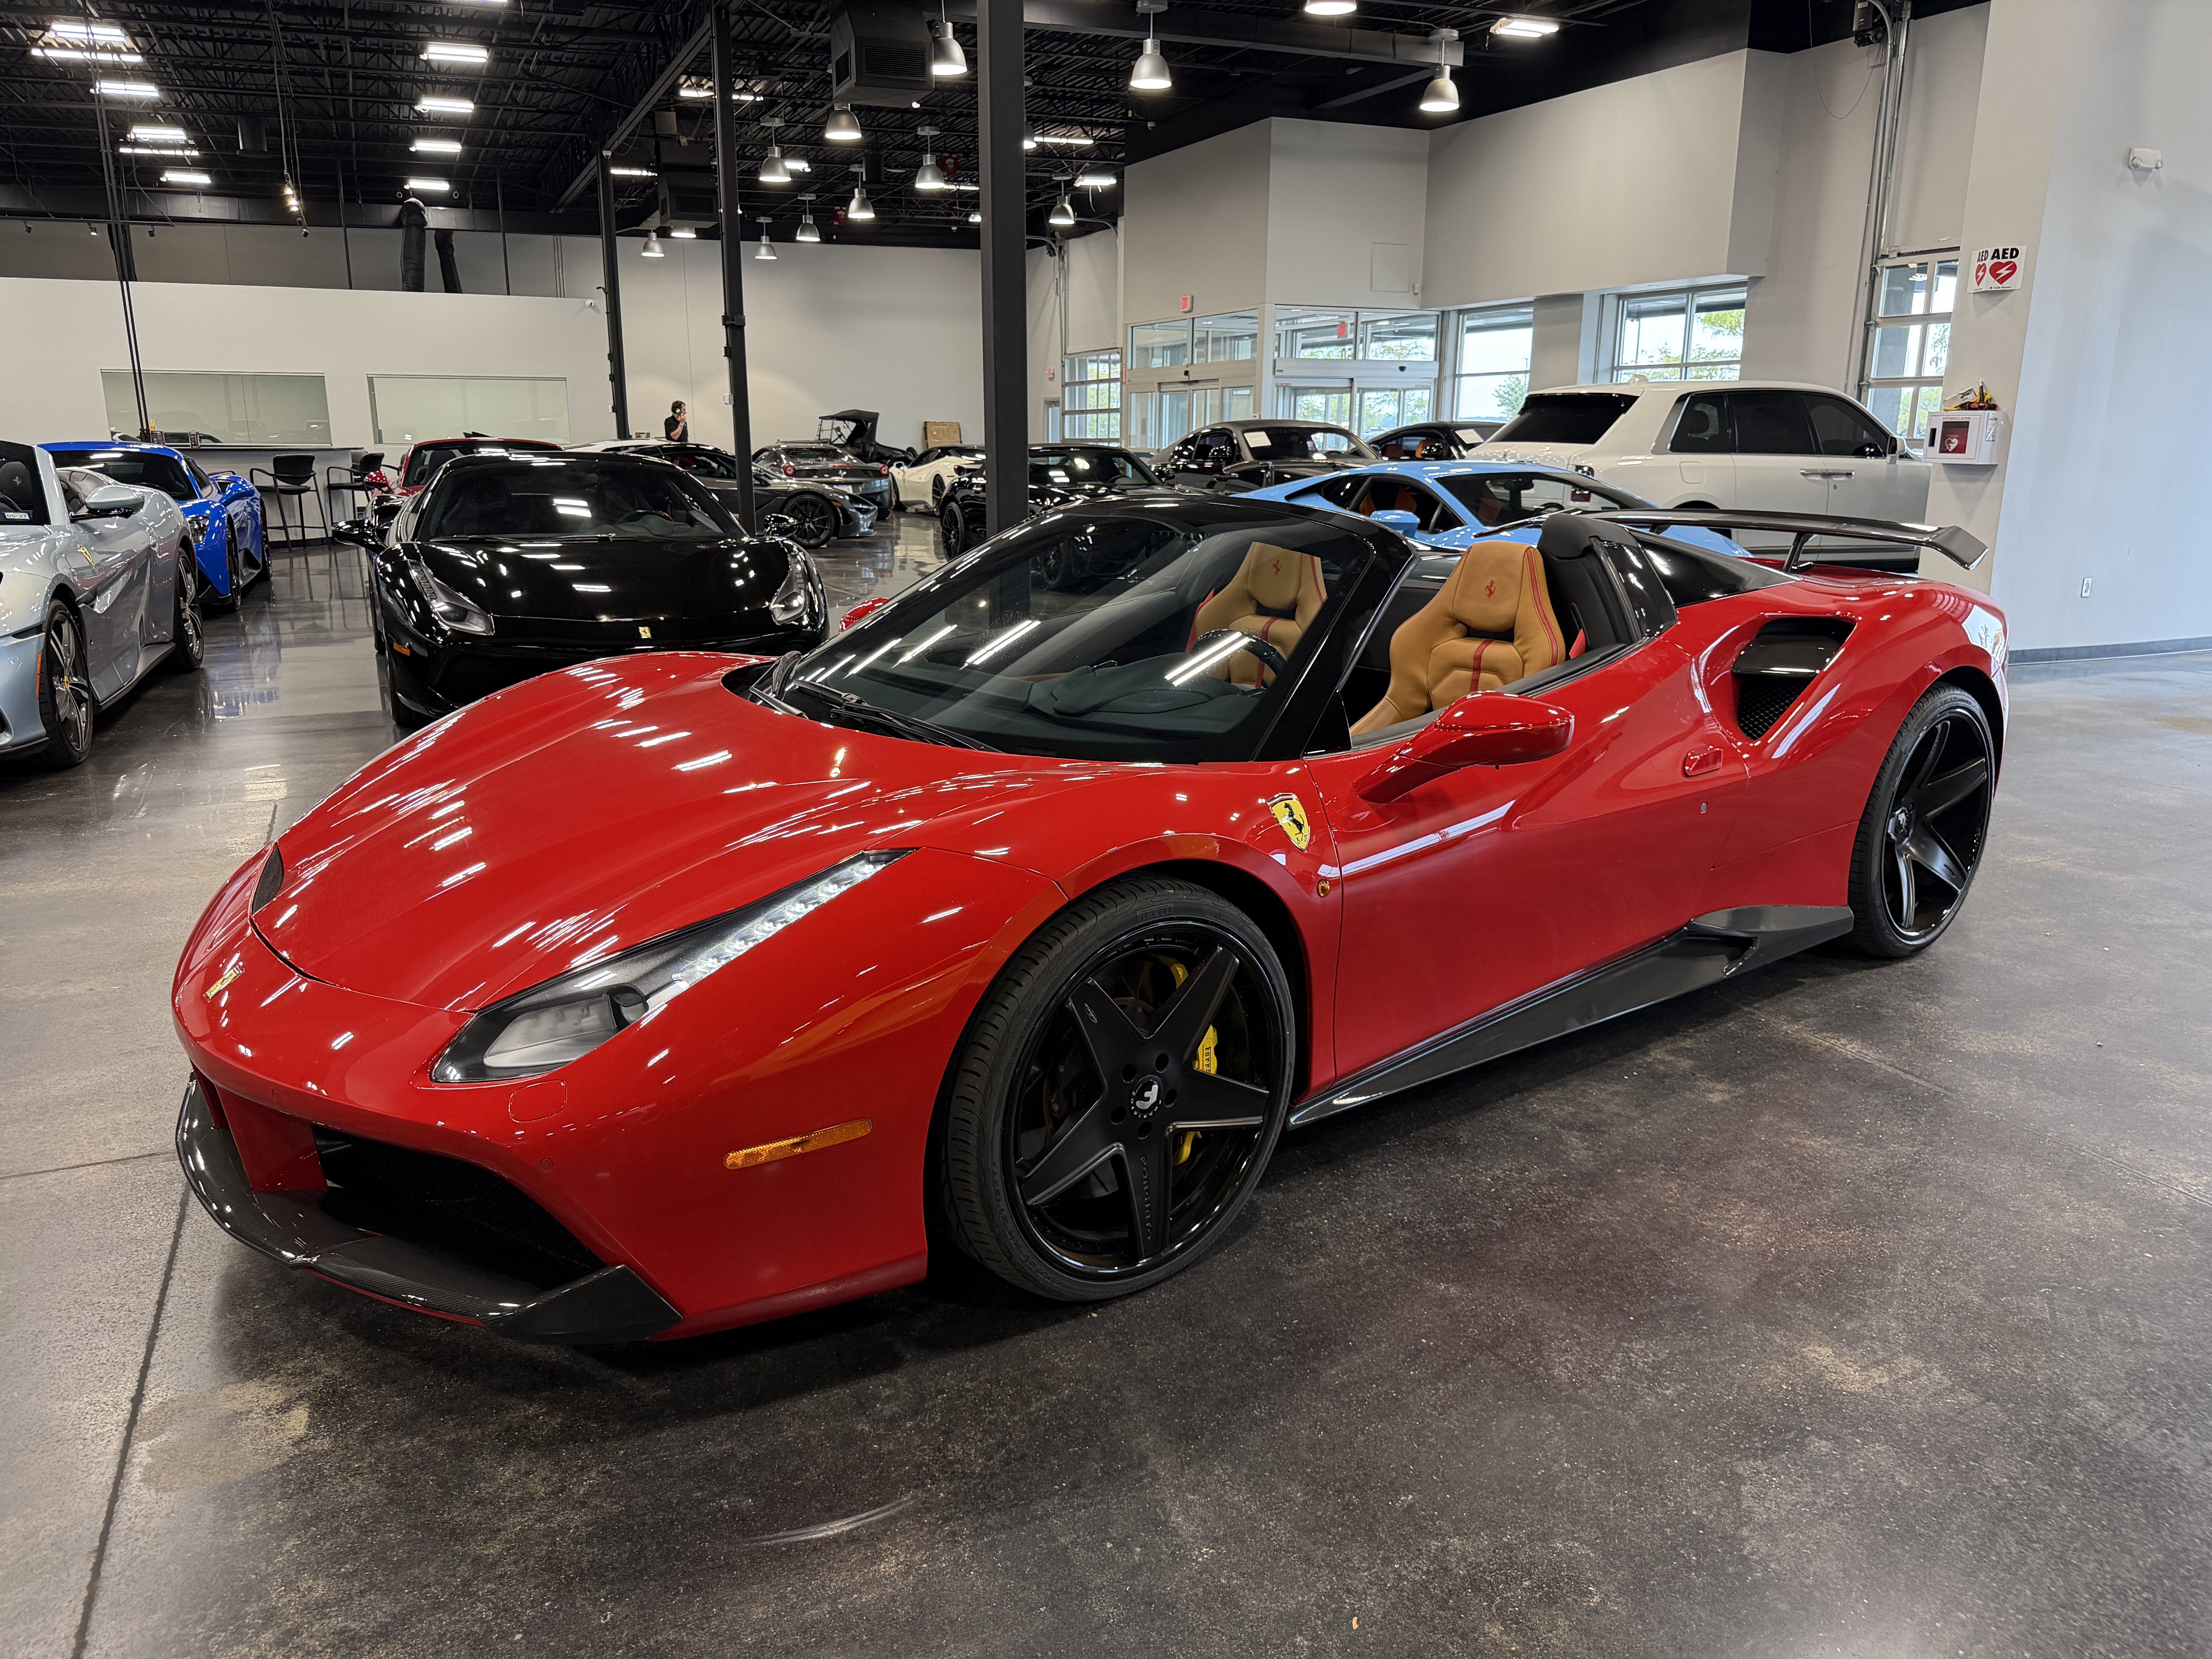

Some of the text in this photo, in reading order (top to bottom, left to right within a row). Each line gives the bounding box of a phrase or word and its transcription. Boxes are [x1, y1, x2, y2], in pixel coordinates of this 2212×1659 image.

[1977, 250, 1989, 263] AED
[1990, 247, 2019, 260] AED
[1136, 903, 1174, 922] PIRELLI
